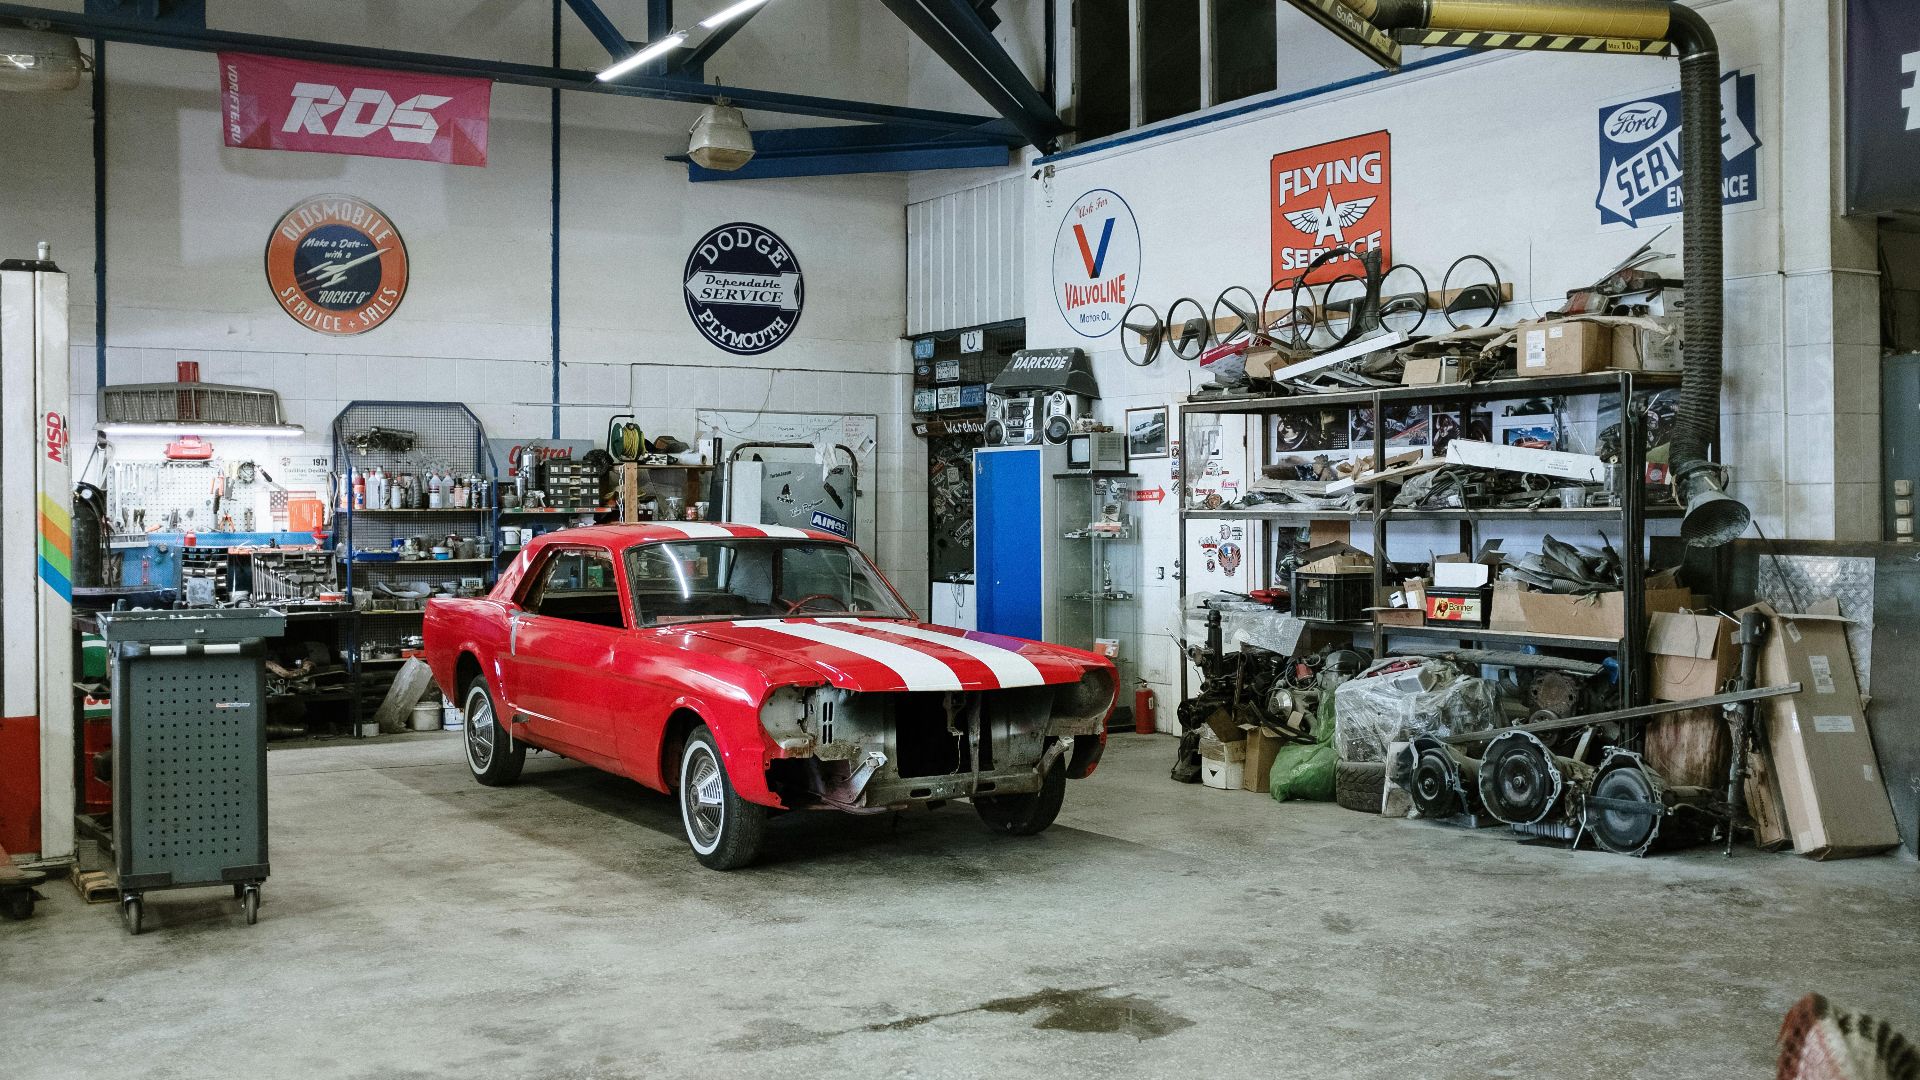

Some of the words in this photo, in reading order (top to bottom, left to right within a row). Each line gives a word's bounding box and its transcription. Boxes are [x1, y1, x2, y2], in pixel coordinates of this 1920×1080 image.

[226, 64, 241, 144] VDRIFTE.RU
[281, 82, 454, 144] RDS
[1610, 109, 1662, 137] Ford
[1279, 151, 1382, 208] FLYING
[281, 202, 393, 245] OLDSMOBILE
[302, 238, 330, 249] Make
[324, 249, 343, 260] with
[345, 251, 352, 260] a
[699, 228, 789, 269] DODGE
[699, 287, 784, 303] SERVICE
[704, 274, 782, 289] Dependable
[1064, 273, 1126, 311] VALVOLINE
[280, 286, 342, 332] SERVICE
[358, 287, 398, 327] SALES
[698, 308, 789, 348] PLYMOUTH
[1012, 356, 1068, 370] DARKSIDE
[46, 411, 62, 463] MSD
[313, 458, 328, 467] 1971
[1449, 602, 1473, 611] Banner
